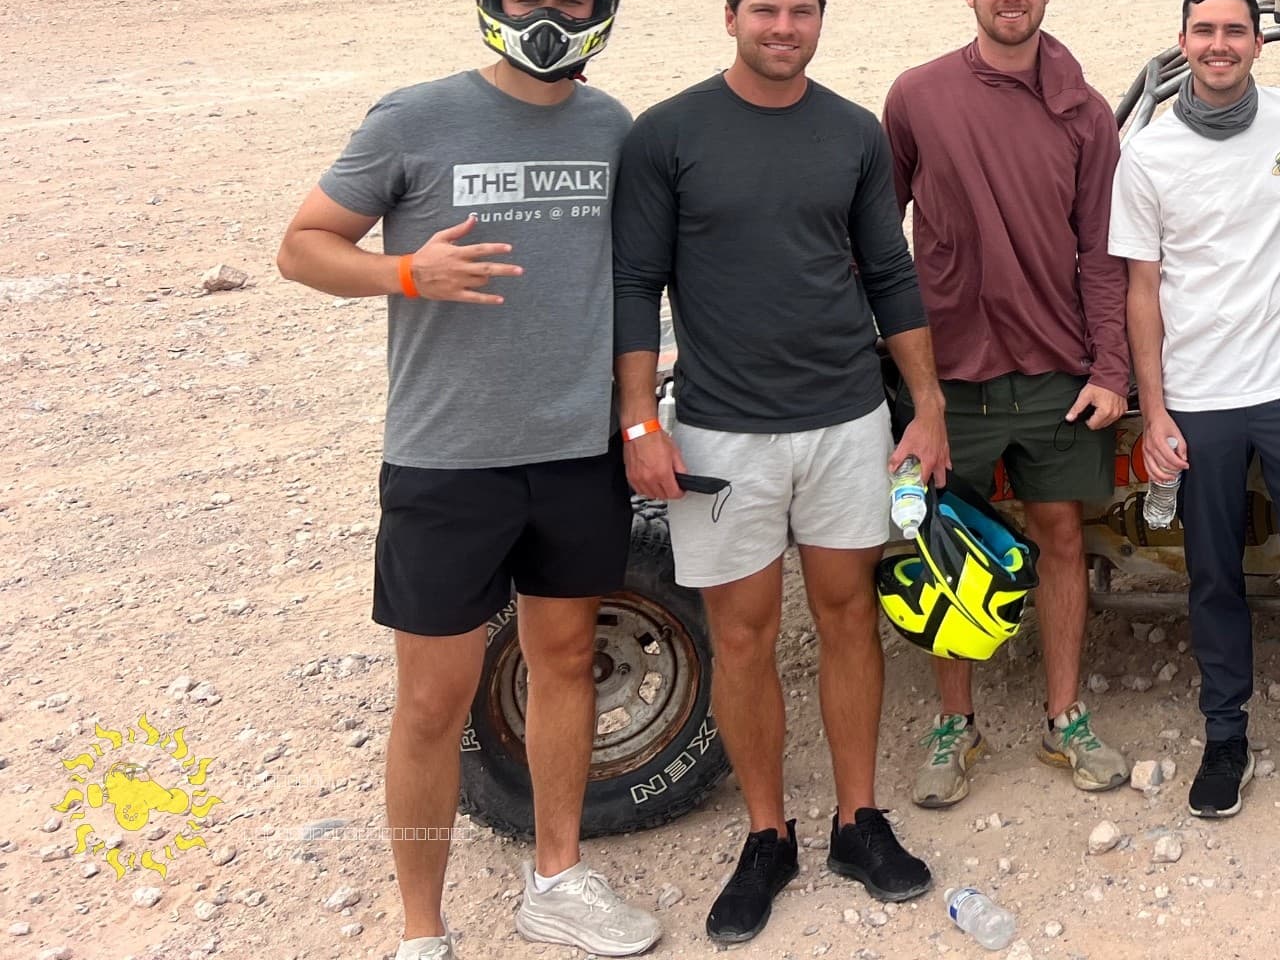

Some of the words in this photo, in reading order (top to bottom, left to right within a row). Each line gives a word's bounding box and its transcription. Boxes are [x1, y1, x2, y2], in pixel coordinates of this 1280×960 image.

[461, 172, 518, 195] THE
[530, 170, 603, 192] WALK
[550, 207, 564, 221] @
[570, 205, 601, 218] 8PM
[630, 700, 718, 805] NEX
